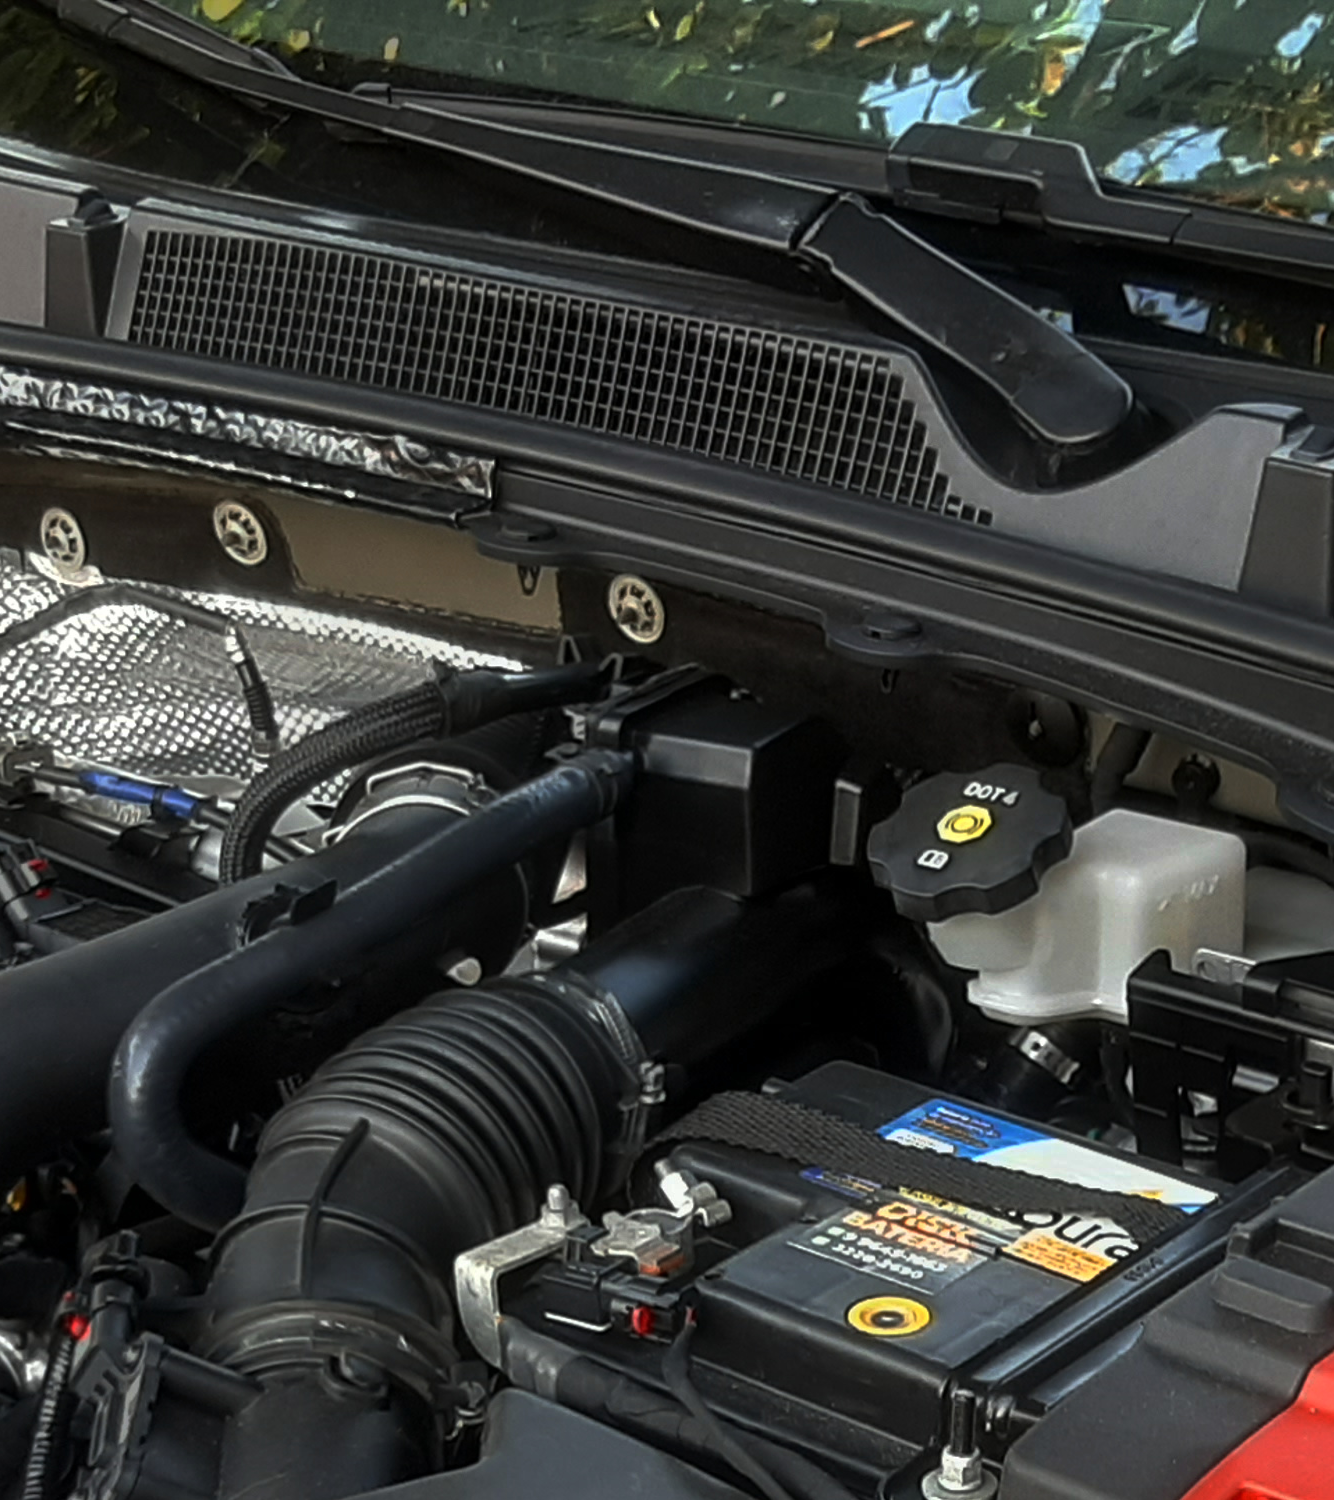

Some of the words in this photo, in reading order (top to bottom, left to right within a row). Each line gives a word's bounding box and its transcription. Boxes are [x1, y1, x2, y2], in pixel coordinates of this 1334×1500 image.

[963, 780, 1005, 803] DOT
[1001, 790, 1022, 807] 4
[842, 1210, 972, 1263] BATERIA
[1000, 1208, 1142, 1261] oura
